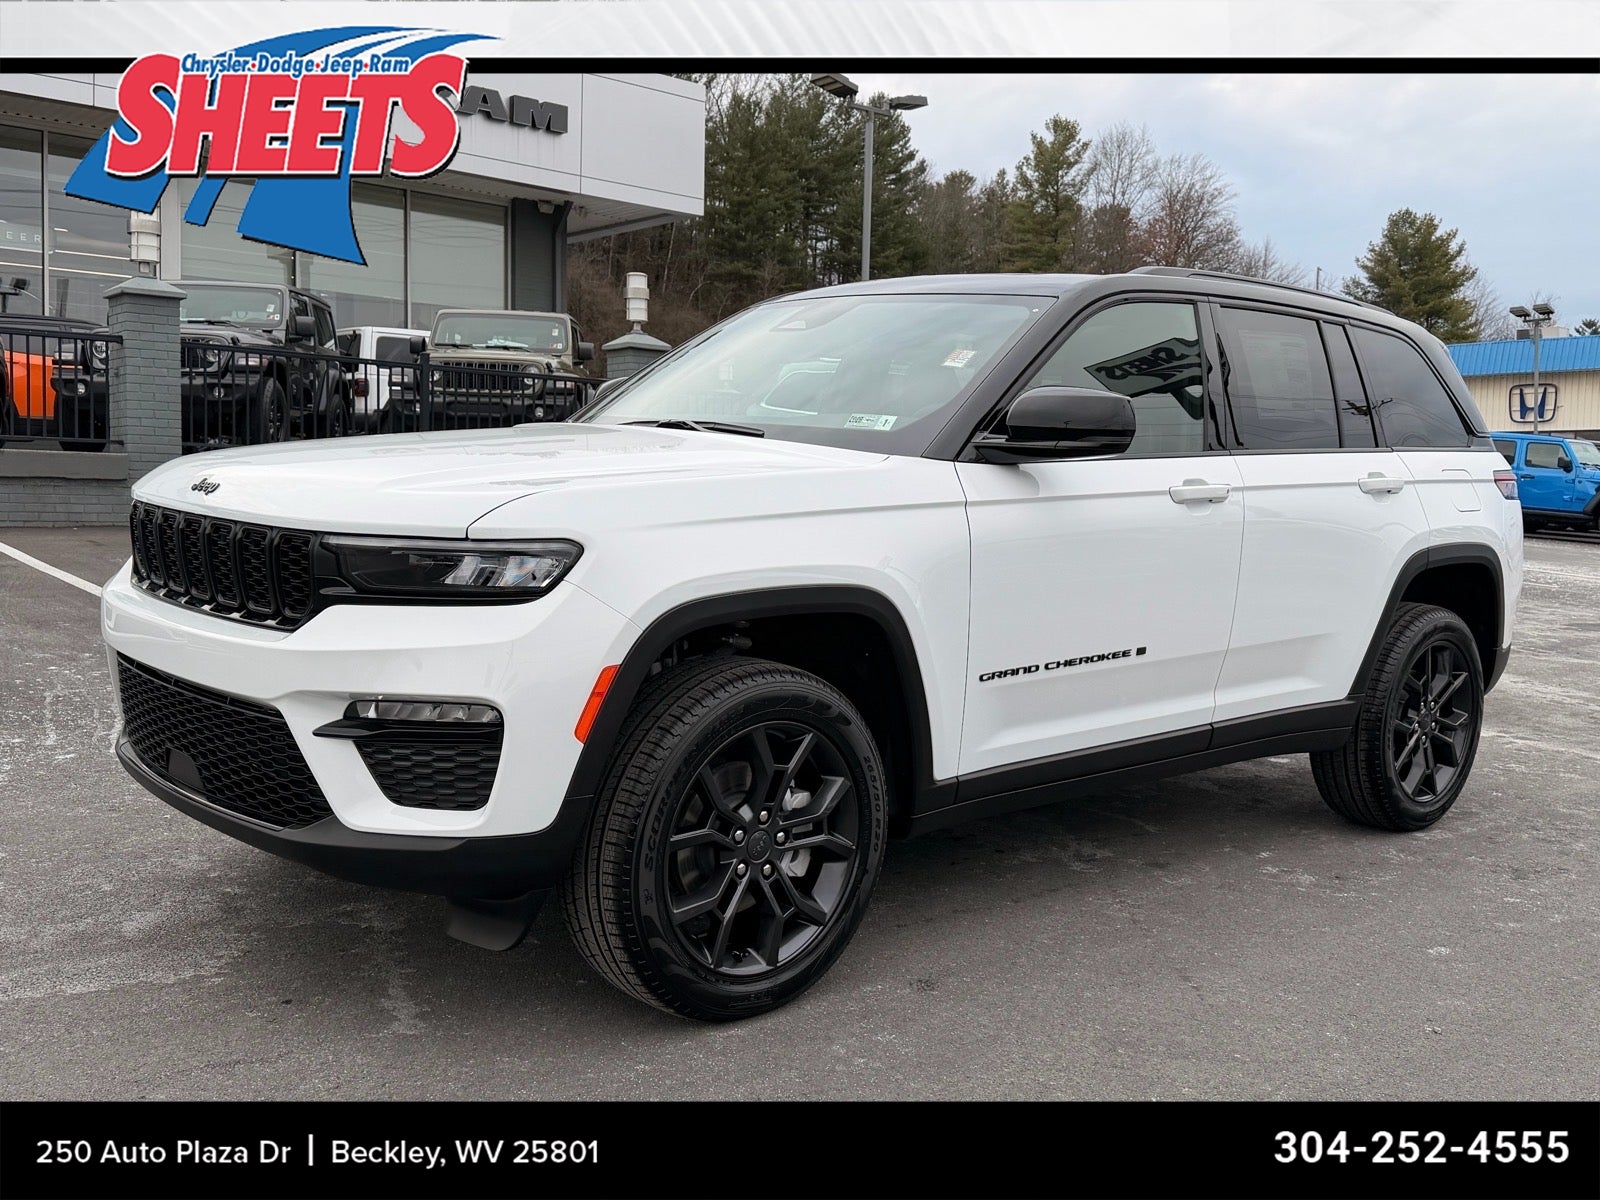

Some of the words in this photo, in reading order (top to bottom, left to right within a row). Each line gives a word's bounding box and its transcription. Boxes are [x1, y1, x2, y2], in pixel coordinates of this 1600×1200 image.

[438, 85, 568, 134] AM
[190, 477, 221, 496] Jeep
[978, 664, 1040, 682] GRAND
[1043, 648, 1133, 671] CHEROKEE
